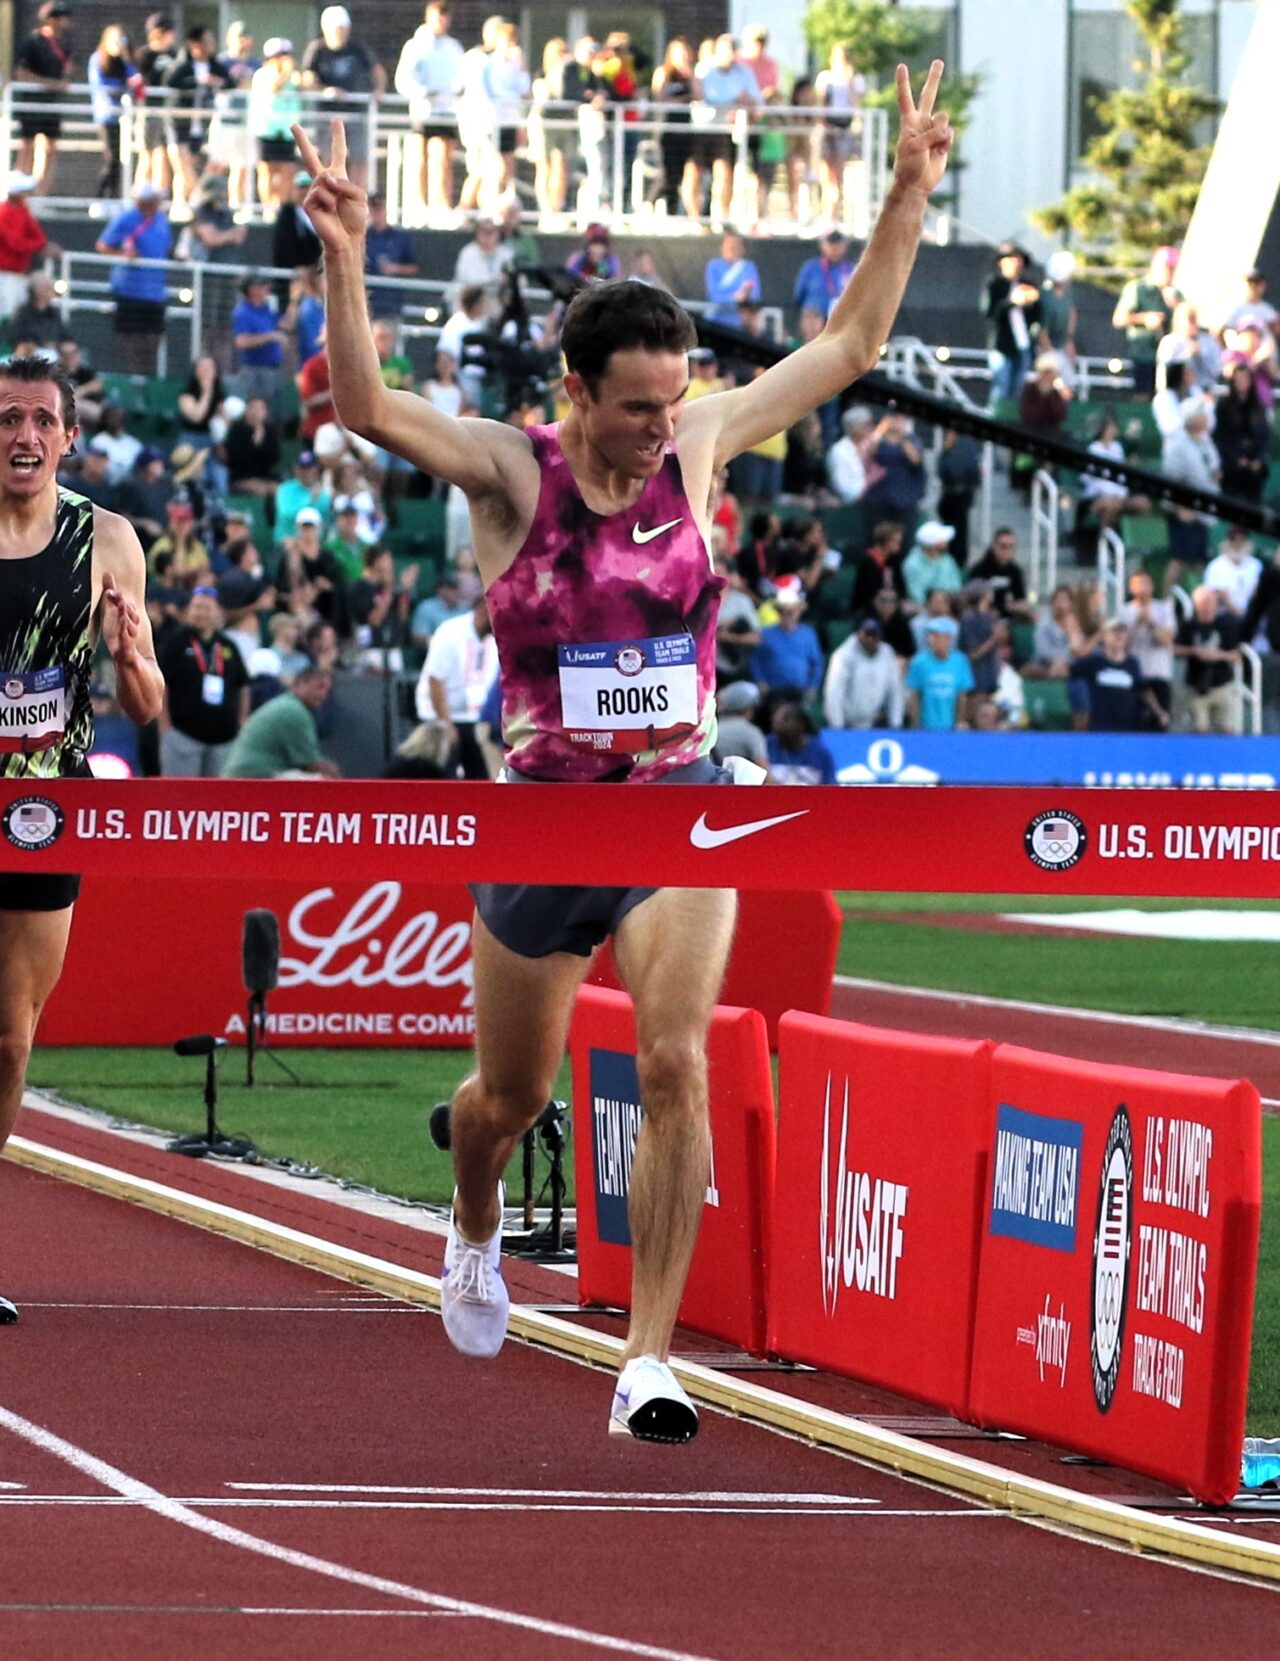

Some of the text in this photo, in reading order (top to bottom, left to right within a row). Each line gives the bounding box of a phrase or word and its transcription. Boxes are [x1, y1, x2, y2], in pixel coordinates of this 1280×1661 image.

[597, 684, 669, 716] ROOKS
[76, 808, 476, 846] U.S. OLYMPIC TEAM TRIALS
[1098, 824, 1154, 858] U.S.
[224, 1013, 245, 1034] A
[254, 1013, 392, 1034] MEDICINE
[594, 1097, 624, 1197] TEAM
[993, 1130, 1078, 1227] MAKING TEAM USA
[1143, 1116, 1213, 1218] U.S. OLYMPIC
[843, 1170, 909, 1299] USATF
[1136, 1225, 1207, 1334] TEAM TRIALS
[1036, 1293, 1071, 1388] xfinity
[1133, 1333, 1157, 1395] TRACK
[1162, 1341, 1184, 1409] FIELD
